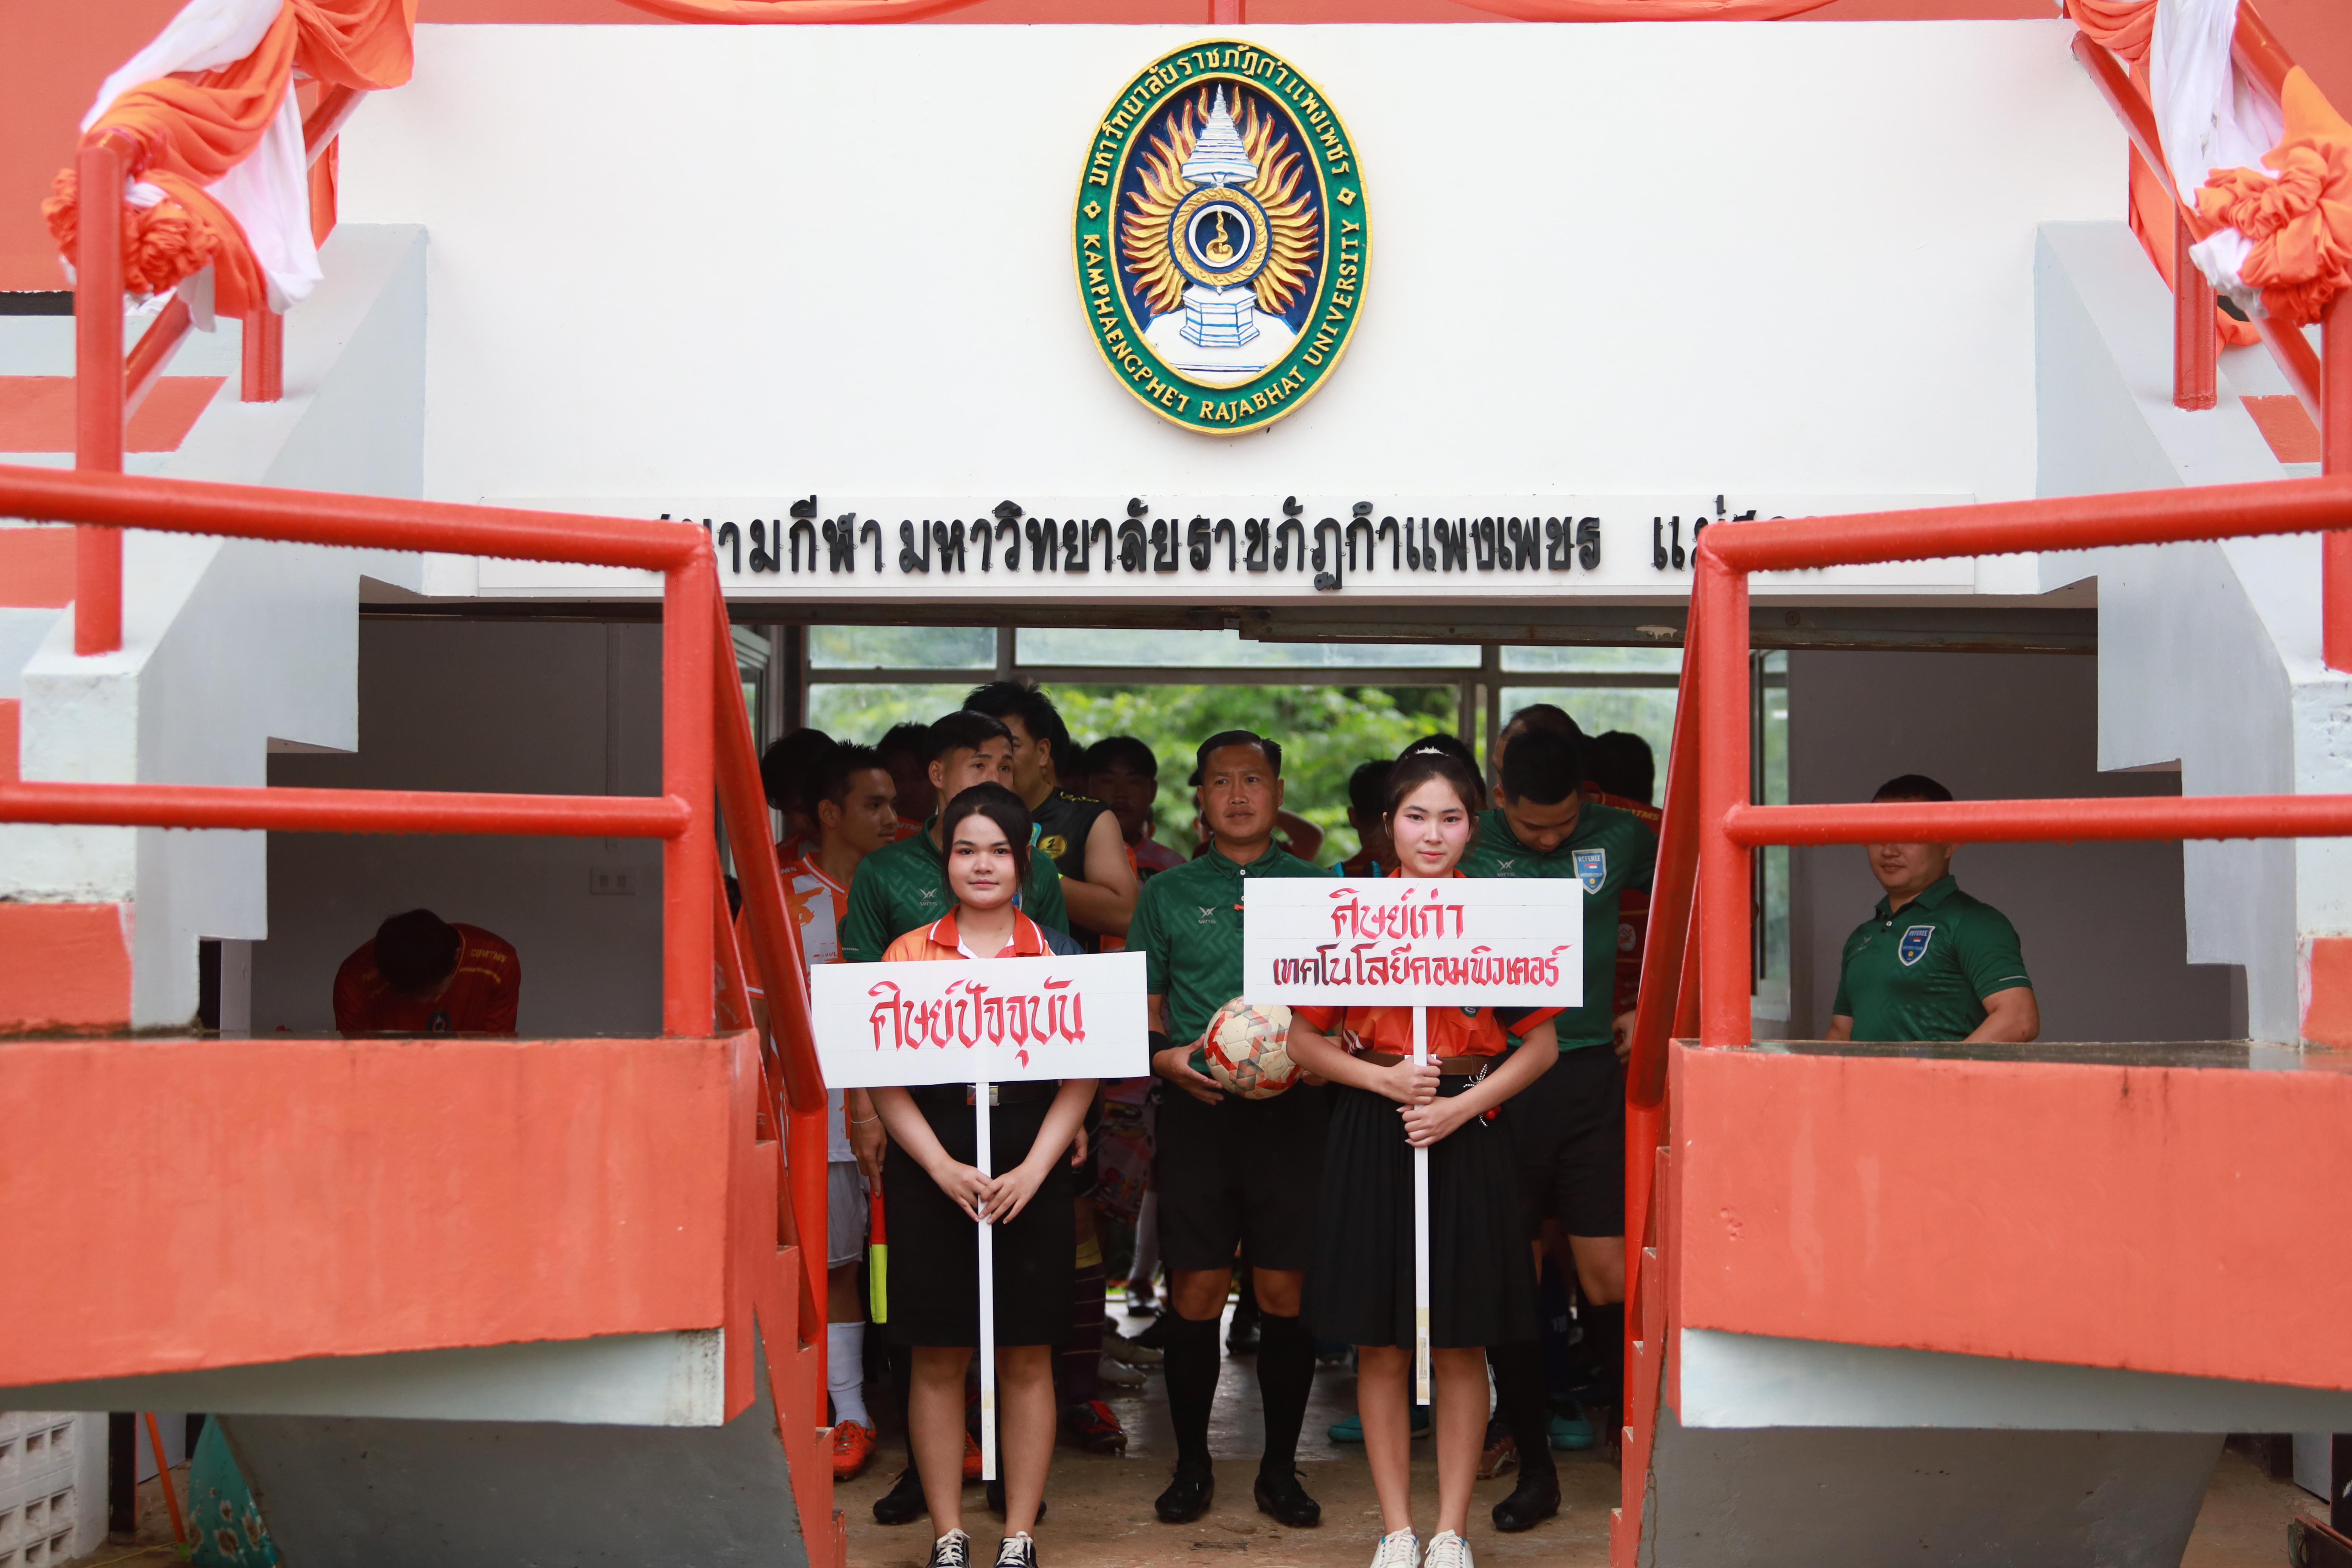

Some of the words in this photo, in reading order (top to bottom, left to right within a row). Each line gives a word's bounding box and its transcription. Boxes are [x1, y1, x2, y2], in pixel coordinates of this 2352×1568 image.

[1199, 365, 1306, 423] RAJABHAT
[1303, 219, 1360, 366] UNIVERSITY
[1273, 940, 1574, 988] เทคโนโลยีคอมพิวเตอร์
[868, 976, 1086, 1070] ศิษย์ปัจจุบัน
